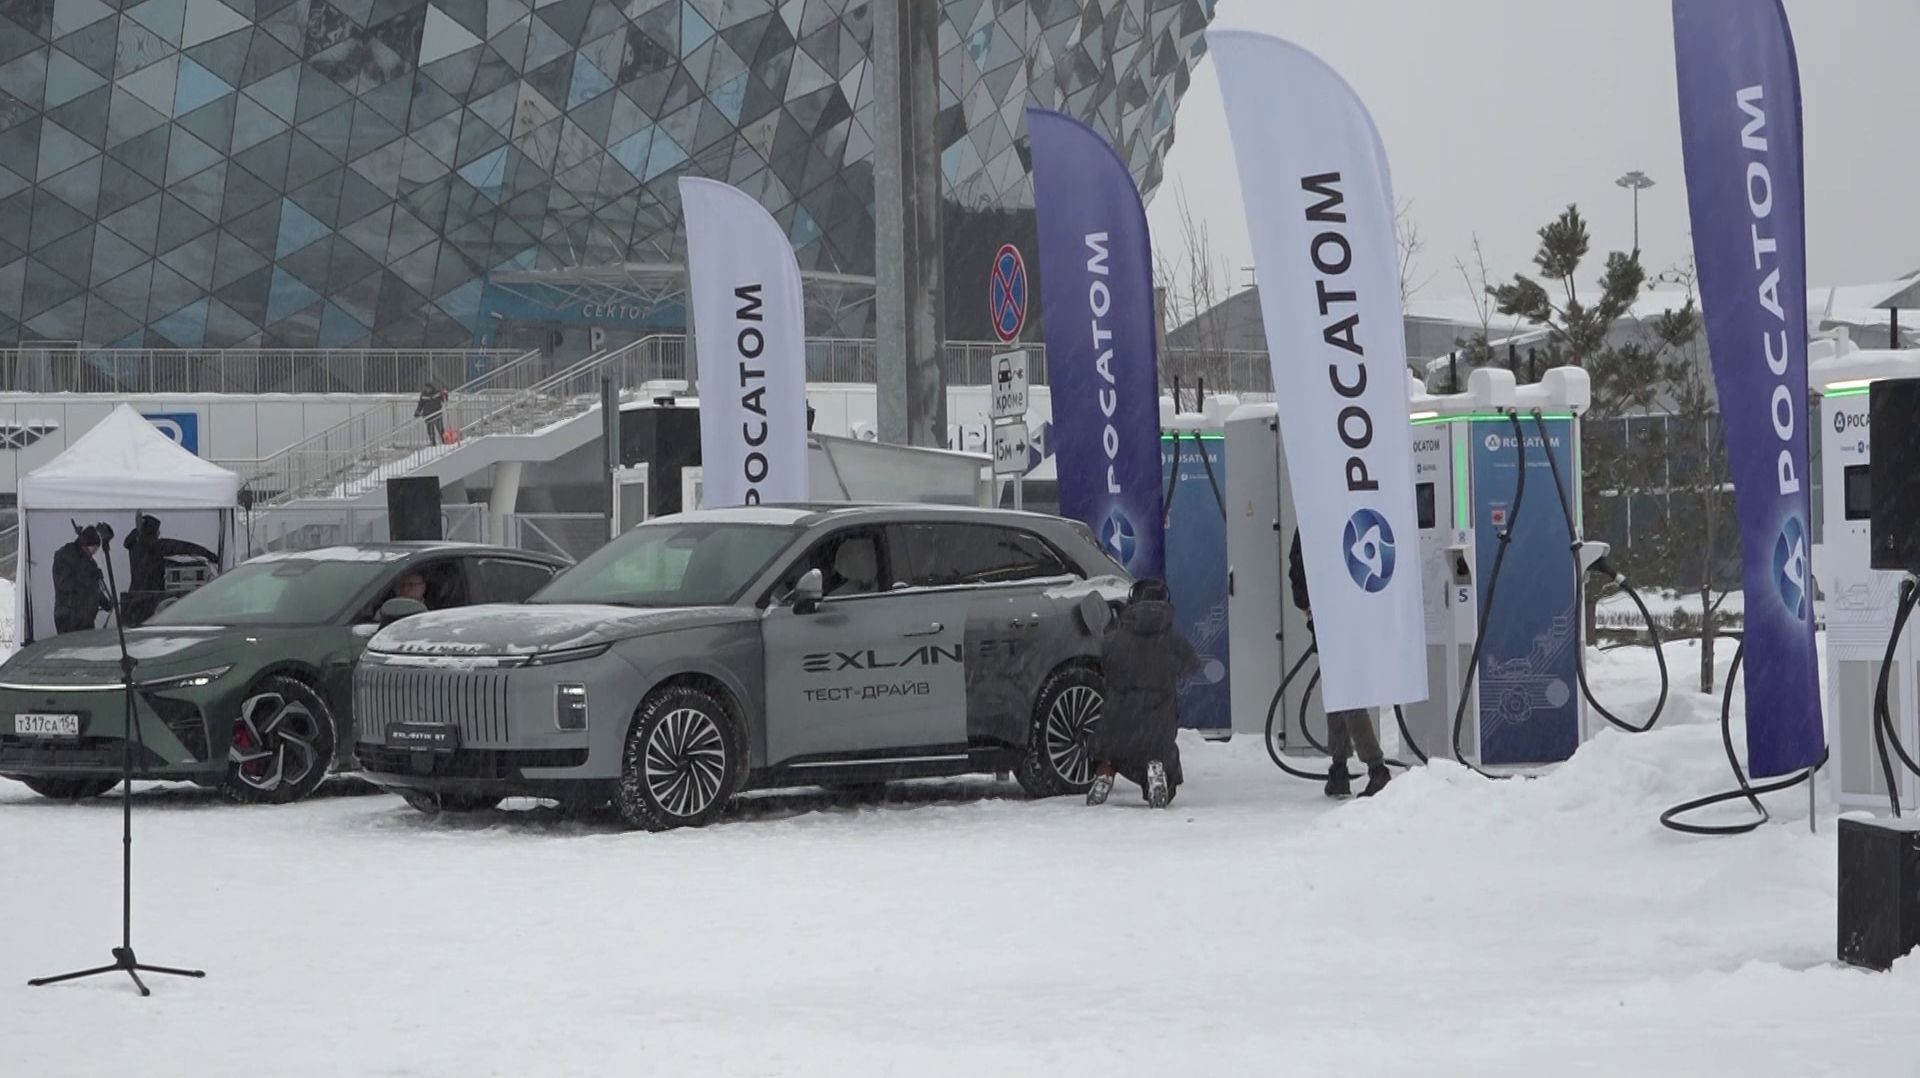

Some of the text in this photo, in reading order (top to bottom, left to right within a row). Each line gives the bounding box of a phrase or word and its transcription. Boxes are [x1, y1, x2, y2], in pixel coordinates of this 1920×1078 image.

[1085, 231, 1121, 494] РОСАТОМ
[1301, 172, 1379, 491] РОСАТОМ
[1736, 85, 1800, 495] РОСАТОМ
[803, 681, 930, 702] ТЕСТ-ДРАЙВ
[1458, 588, 1469, 603] 5
